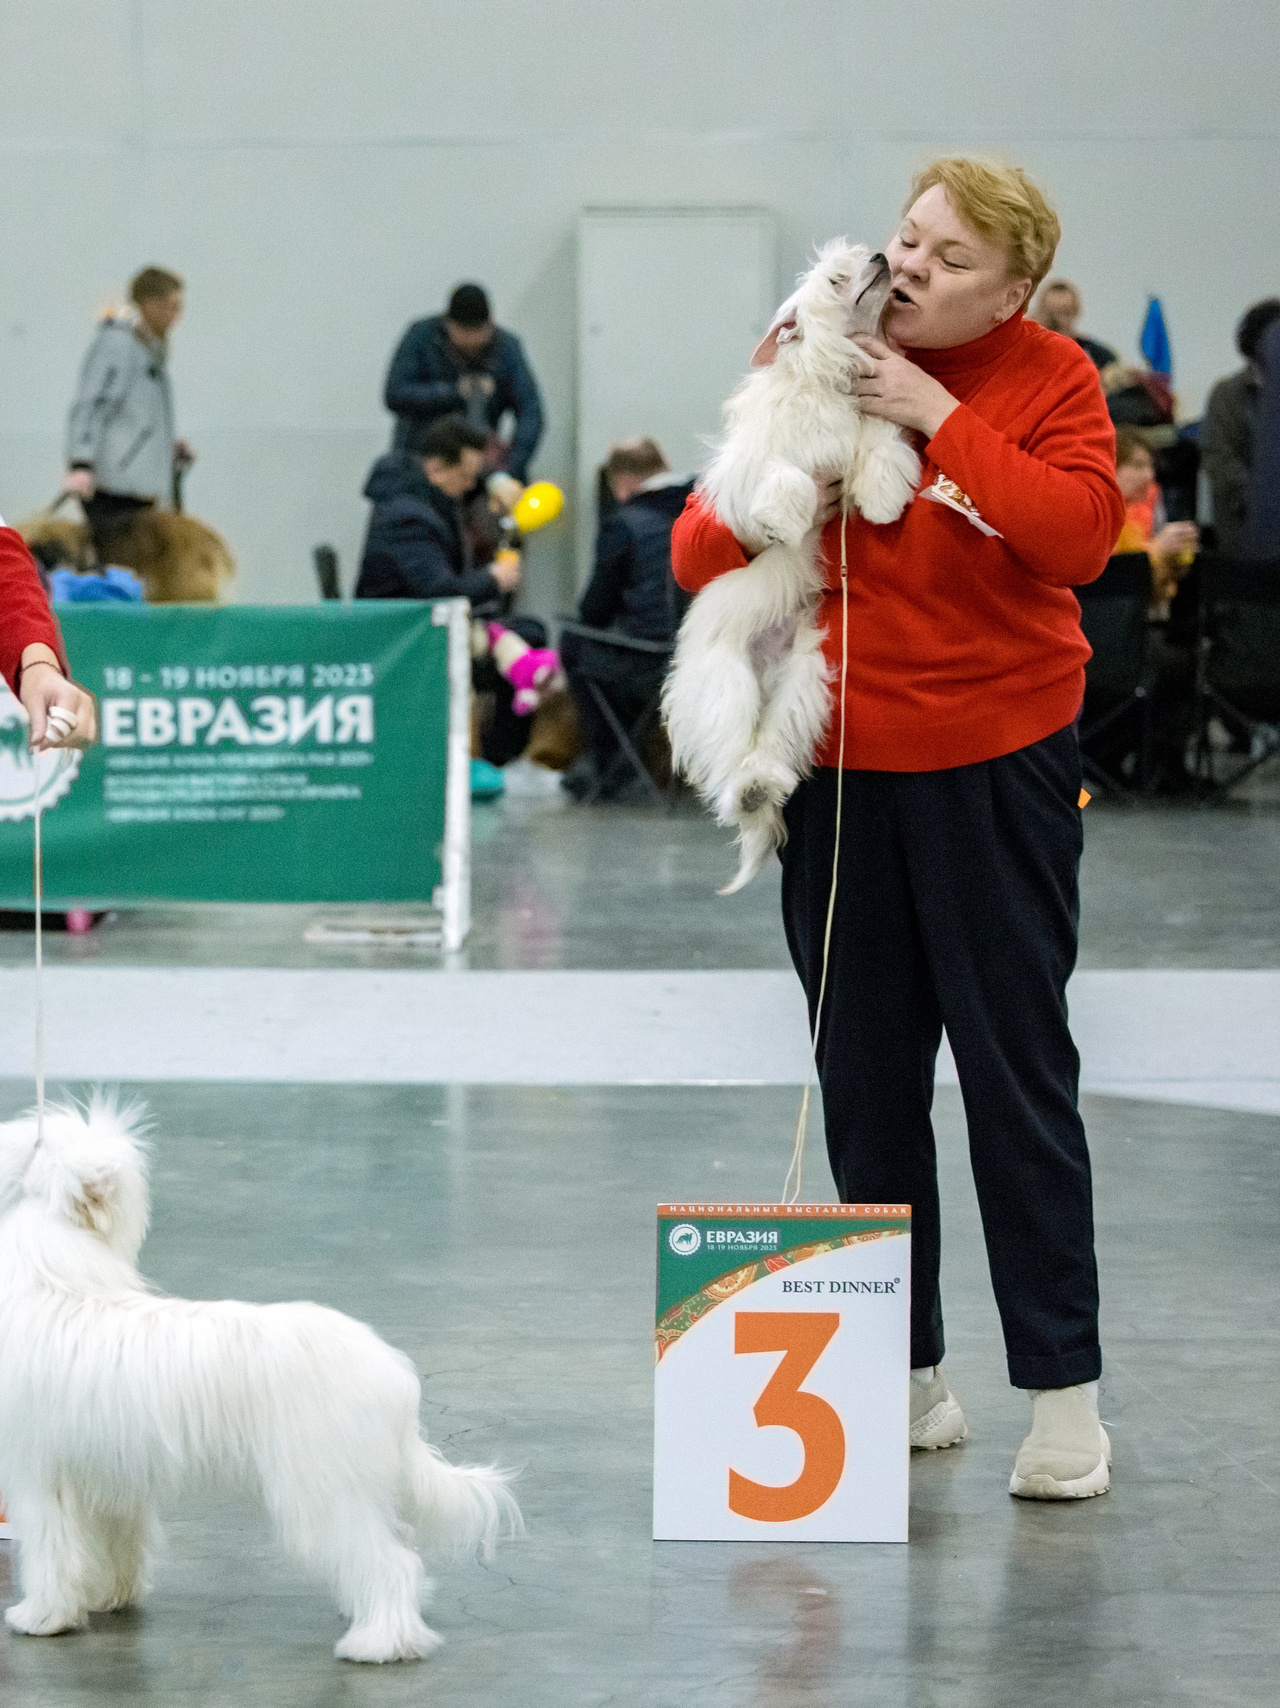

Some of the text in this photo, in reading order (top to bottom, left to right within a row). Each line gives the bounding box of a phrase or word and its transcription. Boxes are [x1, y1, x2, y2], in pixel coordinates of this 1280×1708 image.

[103, 666, 133, 690] 18
[160, 665, 190, 690] 19
[195, 664, 305, 690] НОЯБРЯ
[101, 694, 374, 746] ЕВРАЗИЯ
[670, 1205, 779, 1213] НАЦИОНАЛЬНЫЕ
[706, 1230, 779, 1244] ЕВРАЗИЯ
[782, 1280, 825, 1293] BEST
[728, 1312, 846, 1522] 3
